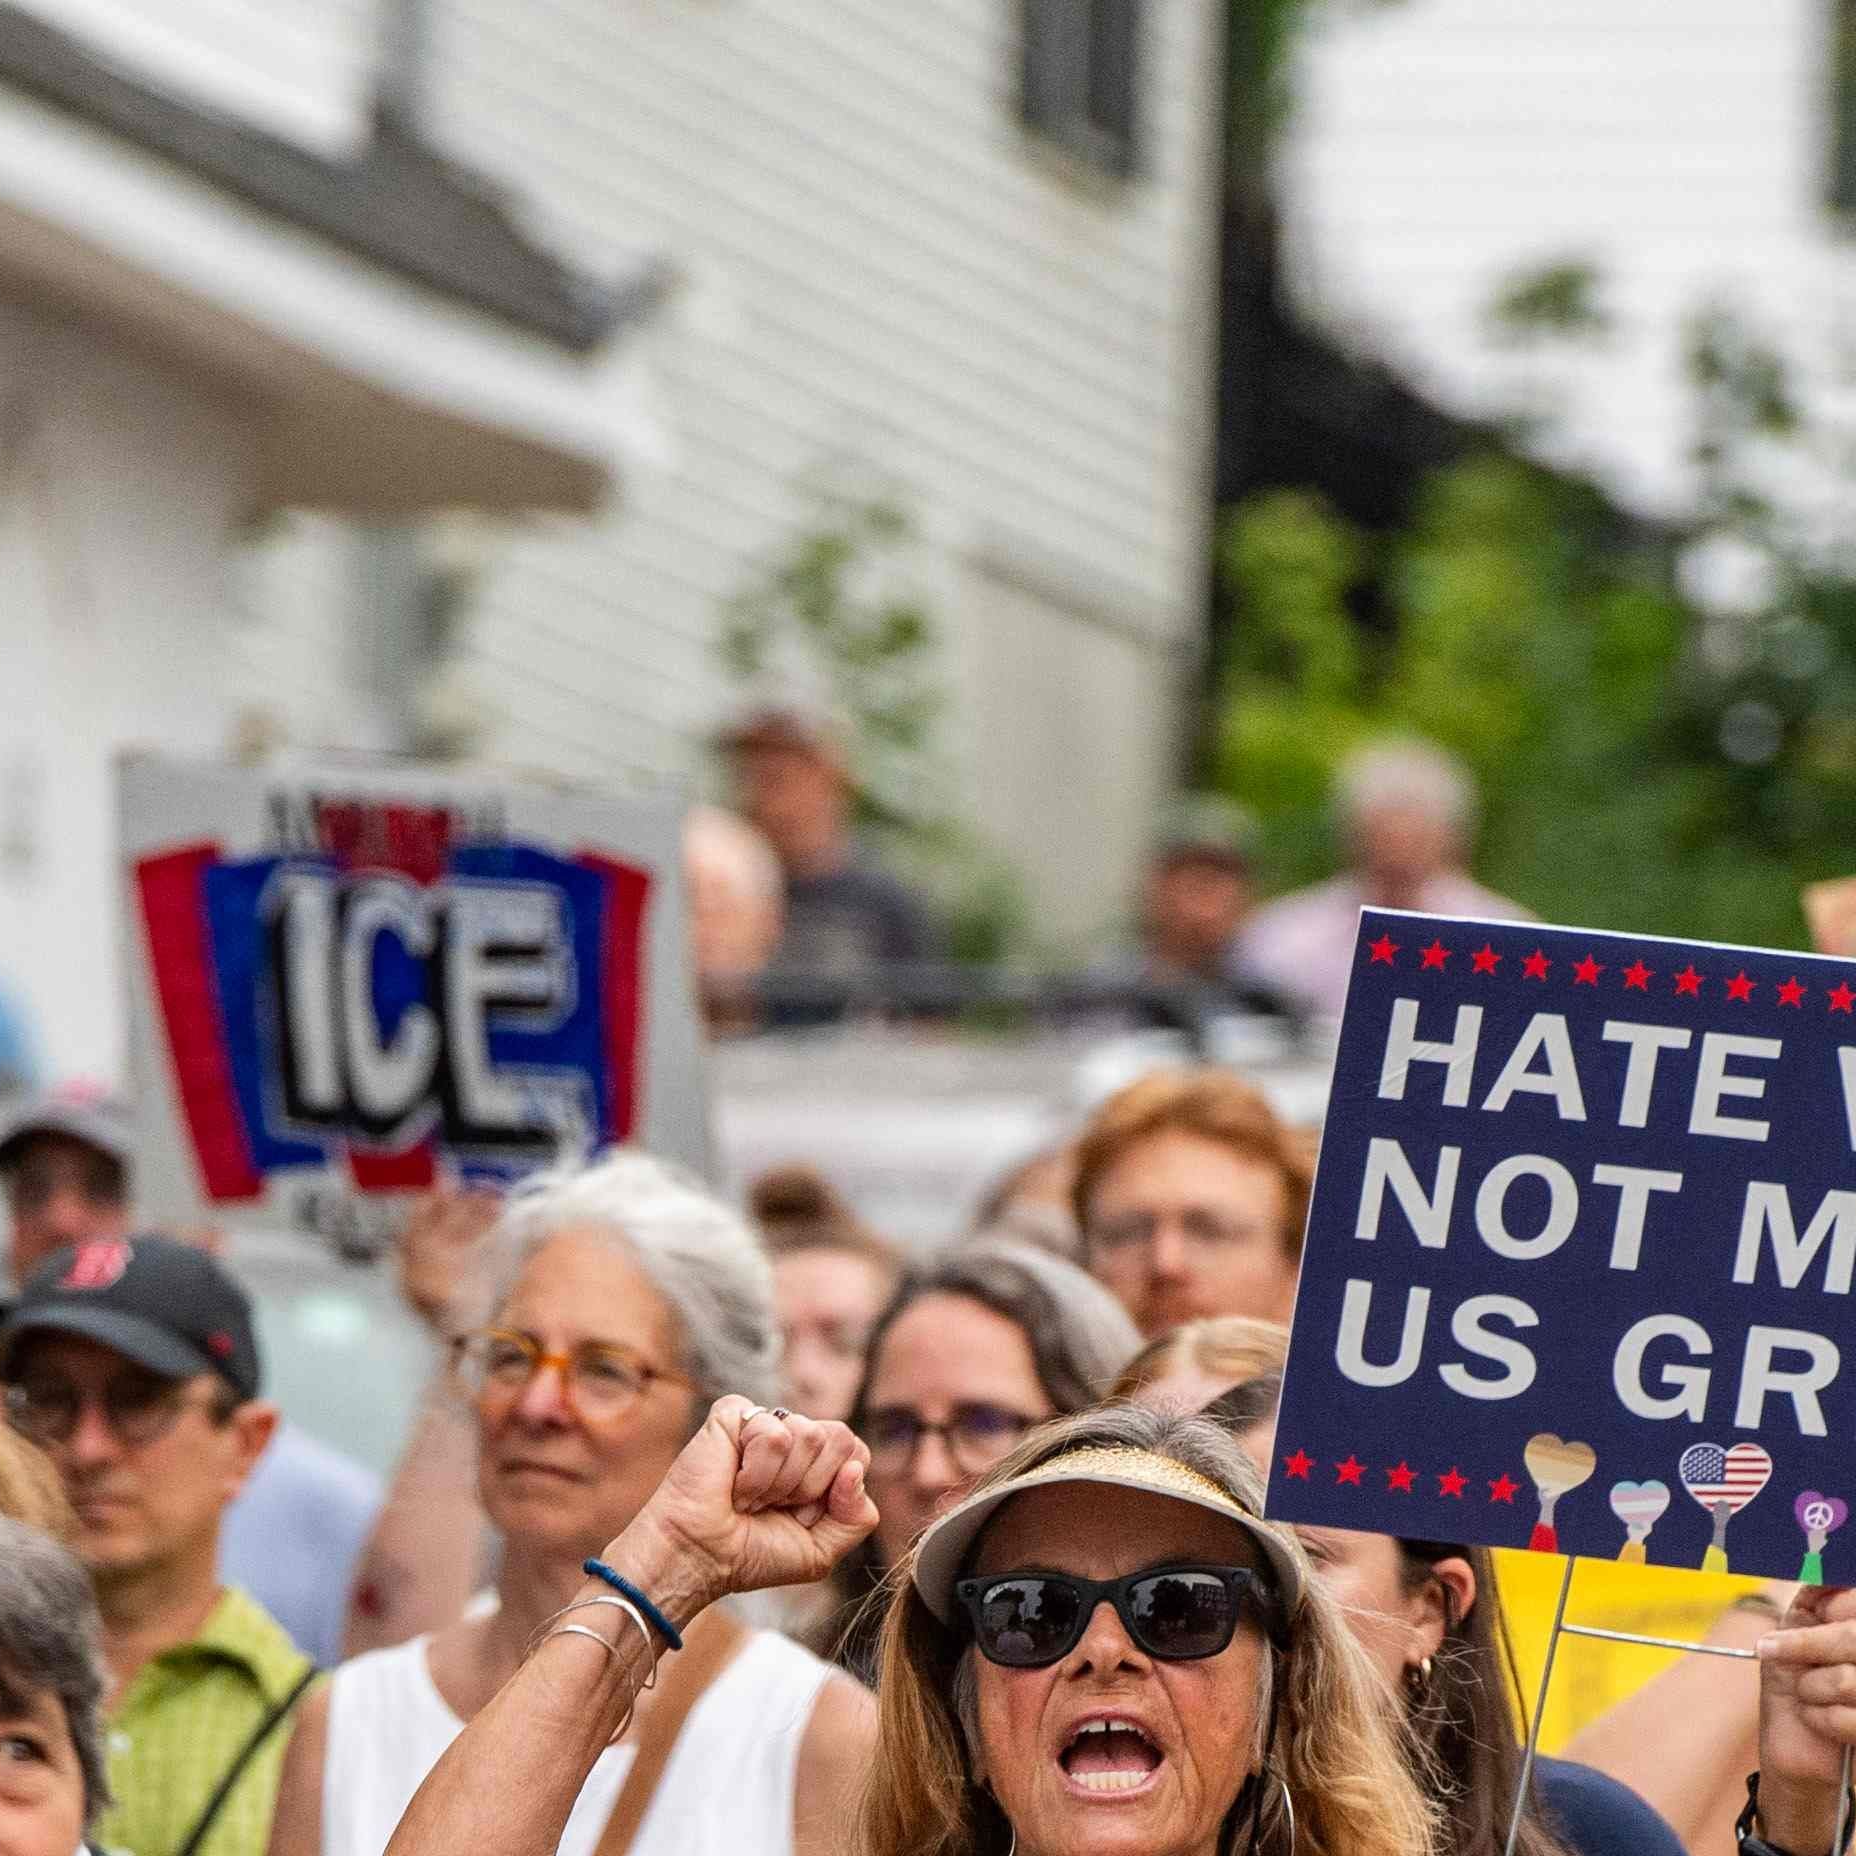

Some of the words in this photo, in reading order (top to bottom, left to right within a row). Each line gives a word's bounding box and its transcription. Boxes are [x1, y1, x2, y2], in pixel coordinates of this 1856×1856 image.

[264, 865, 584, 1155] ICE
[1378, 999, 1782, 1141] HATE
[1356, 1138, 1682, 1270] NOT
[1335, 1279, 1539, 1400] US
